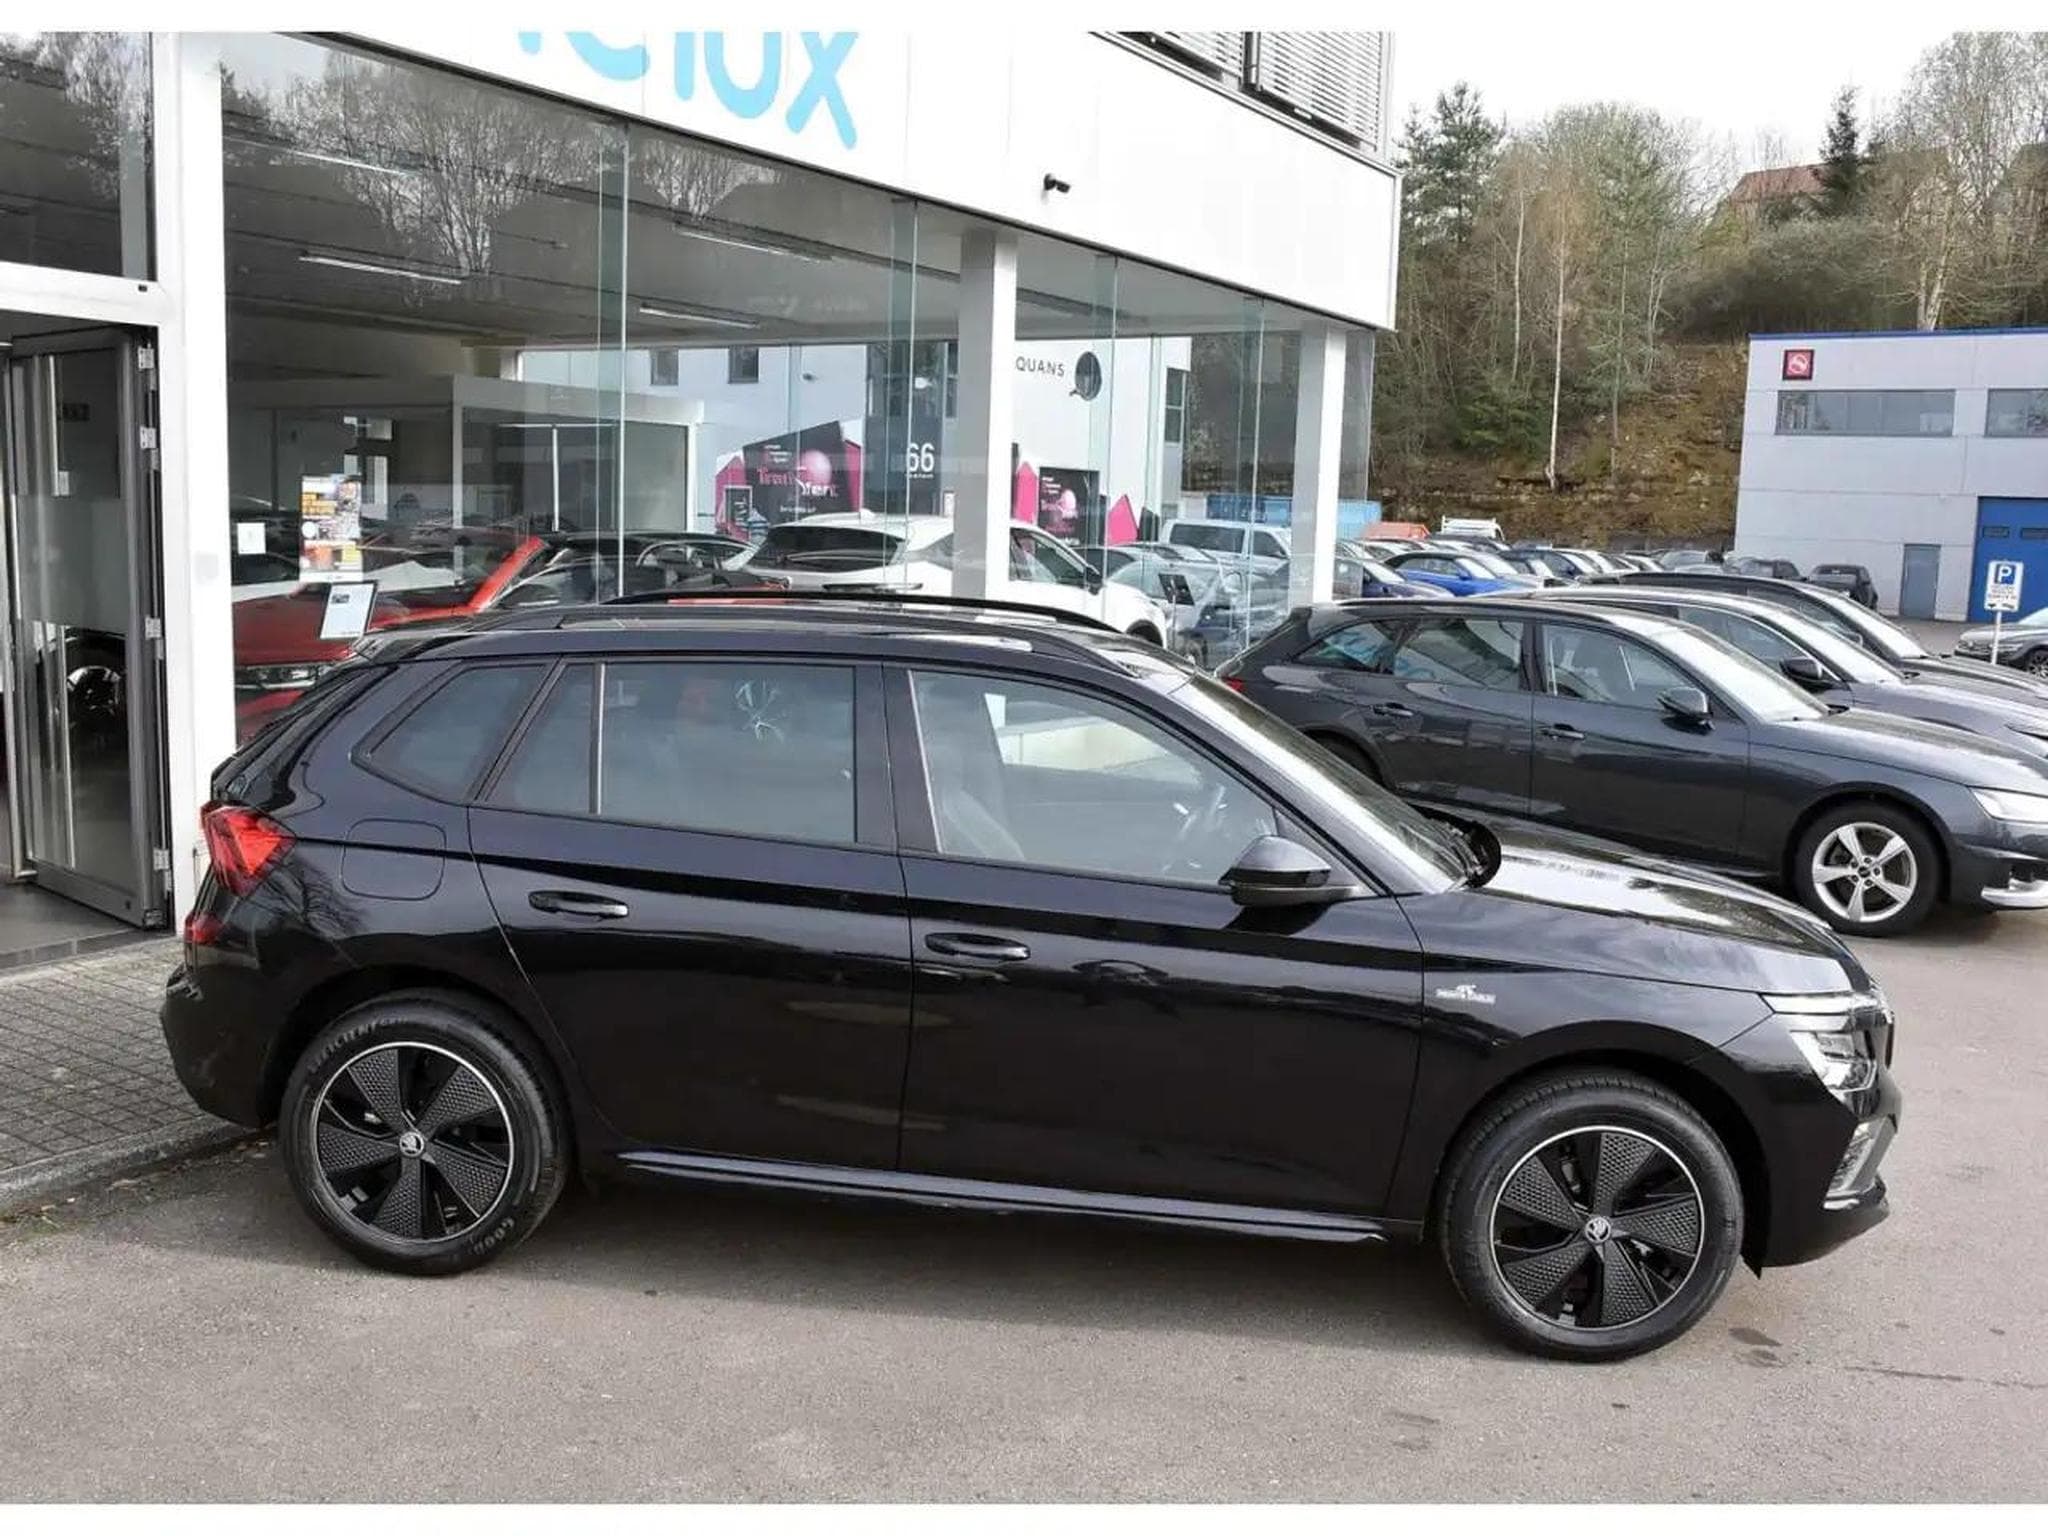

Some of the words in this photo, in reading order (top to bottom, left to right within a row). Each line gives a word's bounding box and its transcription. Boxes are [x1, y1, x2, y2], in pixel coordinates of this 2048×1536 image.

[1015, 356, 1065, 377] QUANS
[906, 442, 935, 472] 66
[1997, 566, 2012, 583] P
